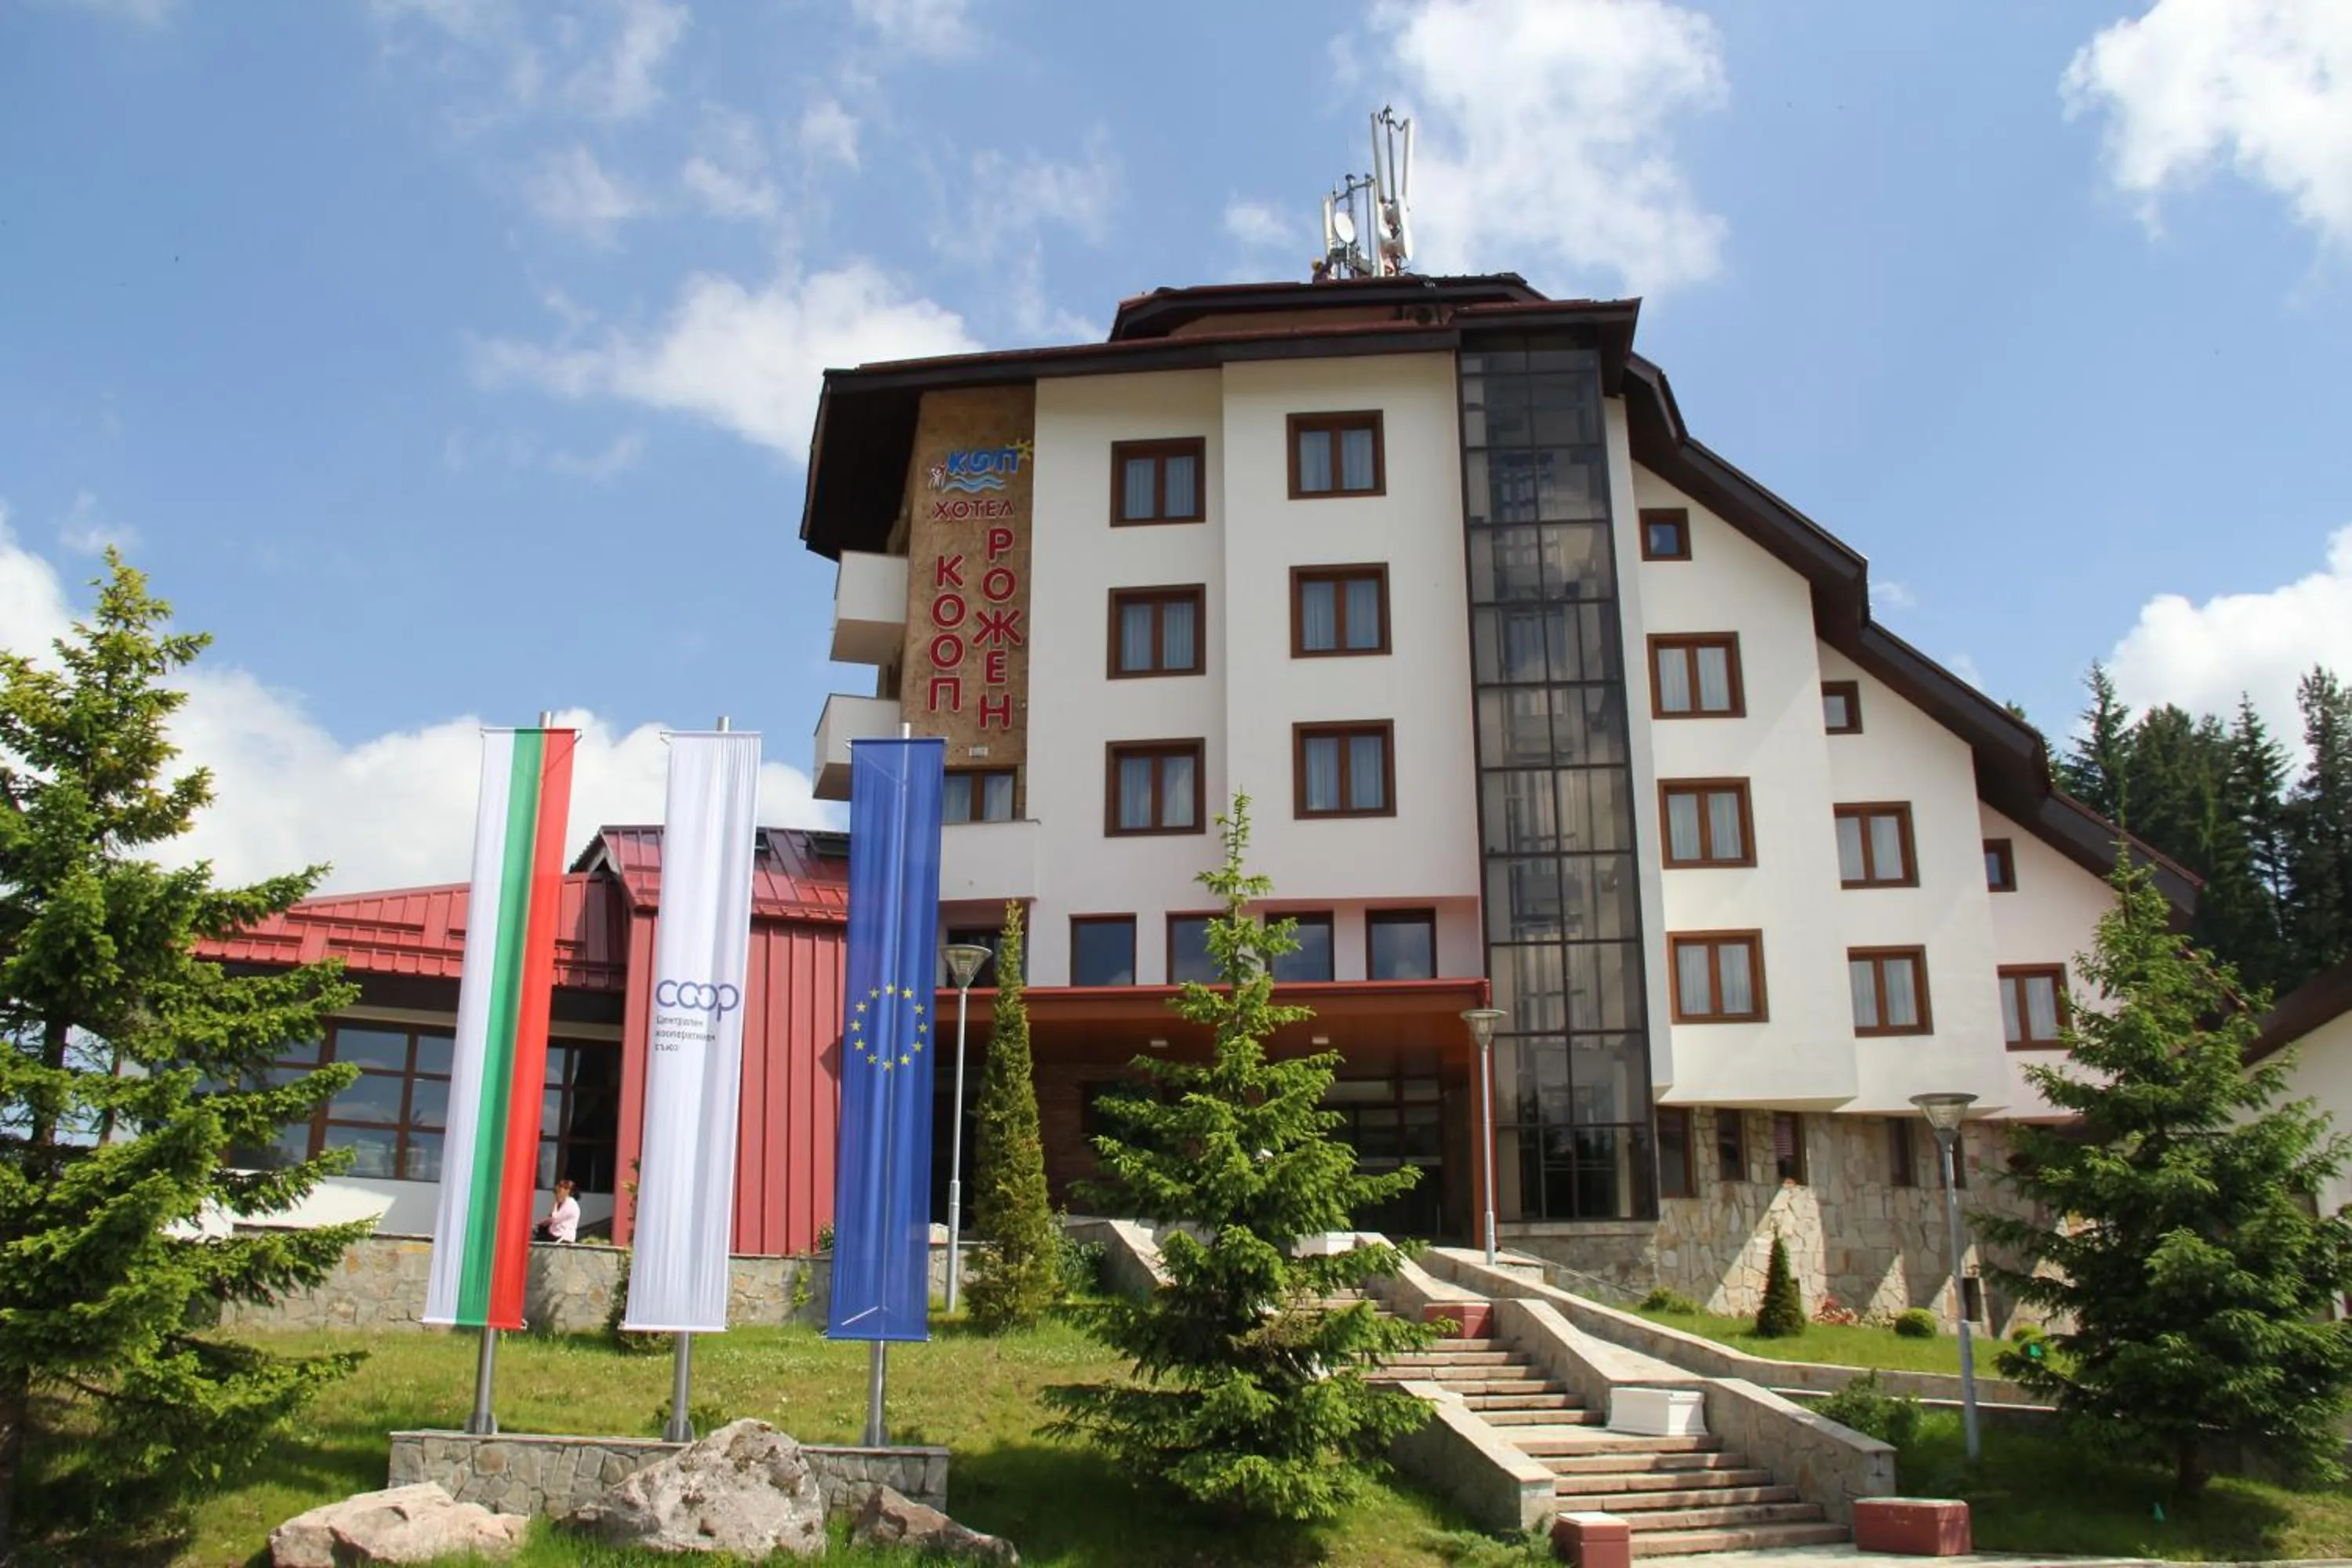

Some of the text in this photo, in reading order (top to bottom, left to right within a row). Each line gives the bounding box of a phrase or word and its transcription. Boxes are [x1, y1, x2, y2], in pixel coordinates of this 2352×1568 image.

[933, 499, 1016, 520] ХОТЕЛ
[928, 554, 967, 712] КООП
[973, 528, 1023, 730] РОЖЕН
